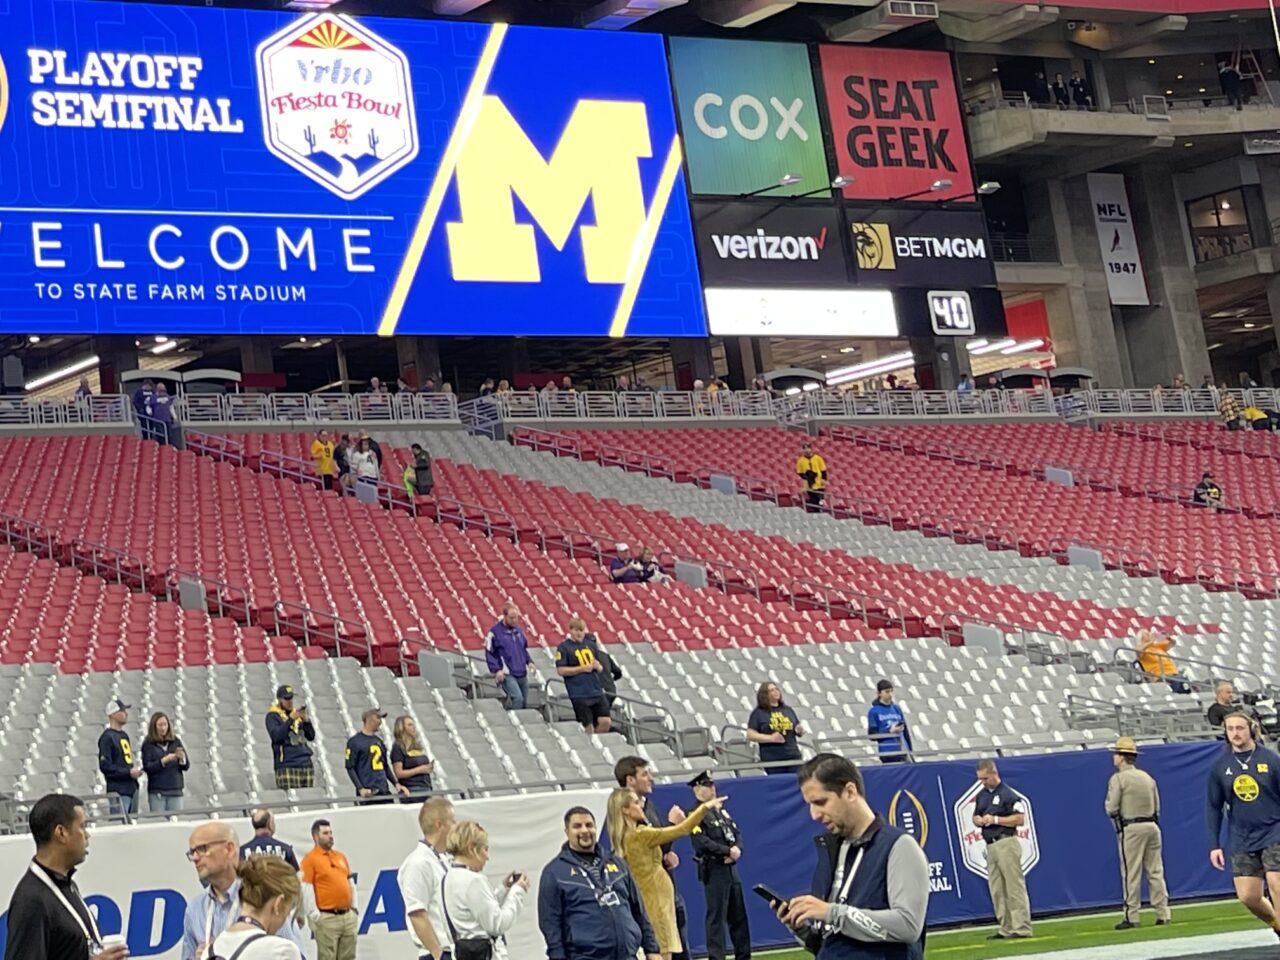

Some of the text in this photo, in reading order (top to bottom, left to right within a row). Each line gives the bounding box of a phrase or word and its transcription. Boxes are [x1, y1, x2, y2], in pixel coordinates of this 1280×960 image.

[27, 48, 203, 86] PLAYOFF
[297, 58, 373, 86] Vrbo
[32, 91, 244, 134] SEMIFINAL
[271, 90, 402, 120] Fiesta Bowl
[844, 75, 939, 122] SEAT
[694, 93, 809, 141] COX
[846, 125, 958, 173] GEEK
[446, 95, 653, 284] M
[1096, 203, 1126, 217] NFL
[711, 227, 819, 261] verizon
[896, 235, 986, 259] BETMGM
[1108, 262, 1137, 274] 1947
[35, 283, 306, 302] TO STATE FARM STADIUM
[933, 297, 970, 329] 40
[574, 648, 595, 667] 10
[120, 738, 133, 765] 9
[369, 744, 384, 771] 2
